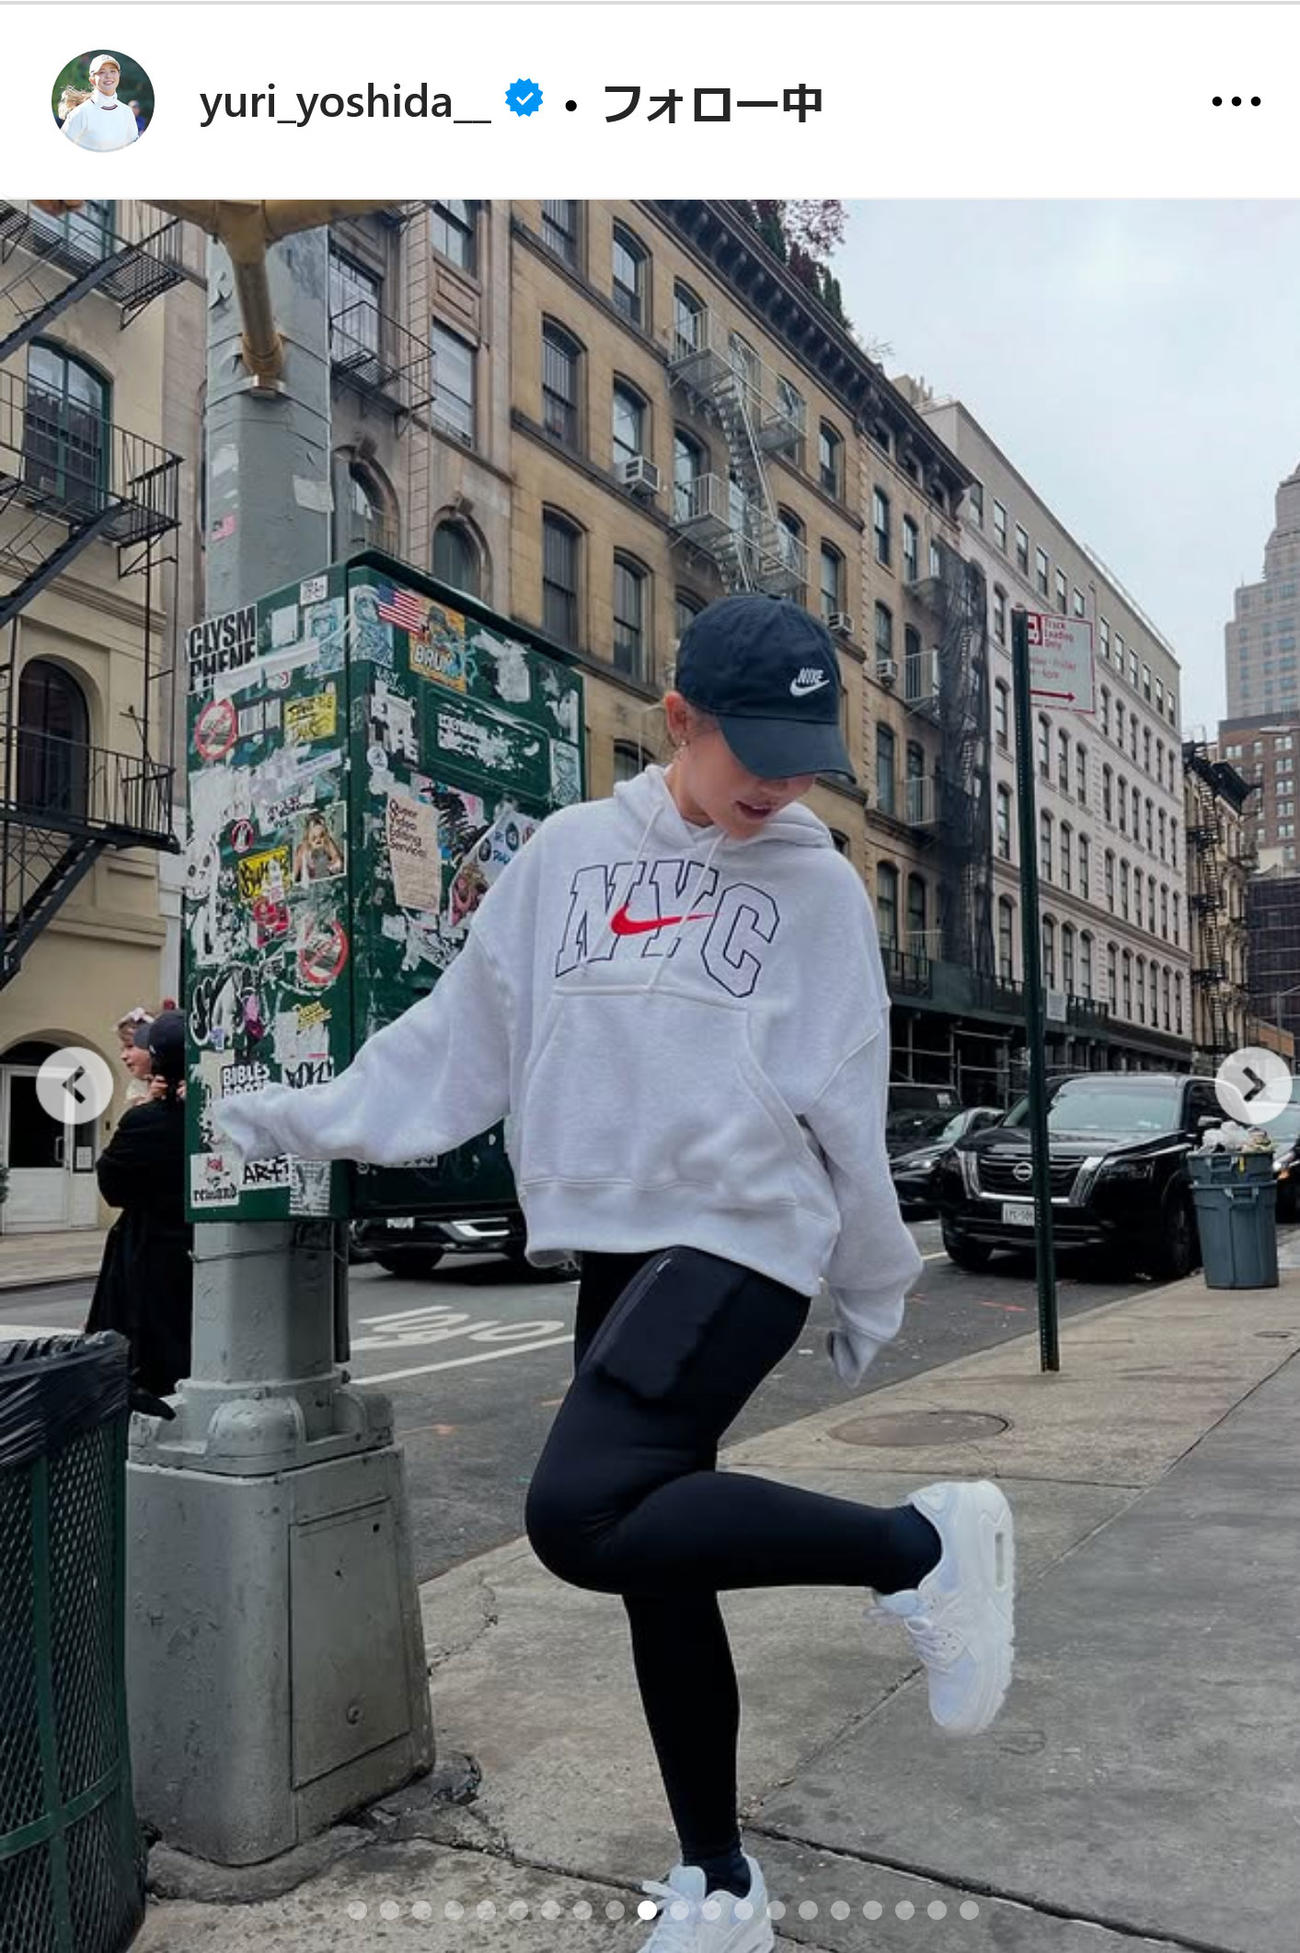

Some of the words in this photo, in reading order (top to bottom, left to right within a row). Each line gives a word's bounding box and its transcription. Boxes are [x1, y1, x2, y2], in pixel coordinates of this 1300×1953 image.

[190, 606, 256, 659] CLYSM
[798, 667, 824, 685] NIKE
[556, 859, 780, 998] NYC
